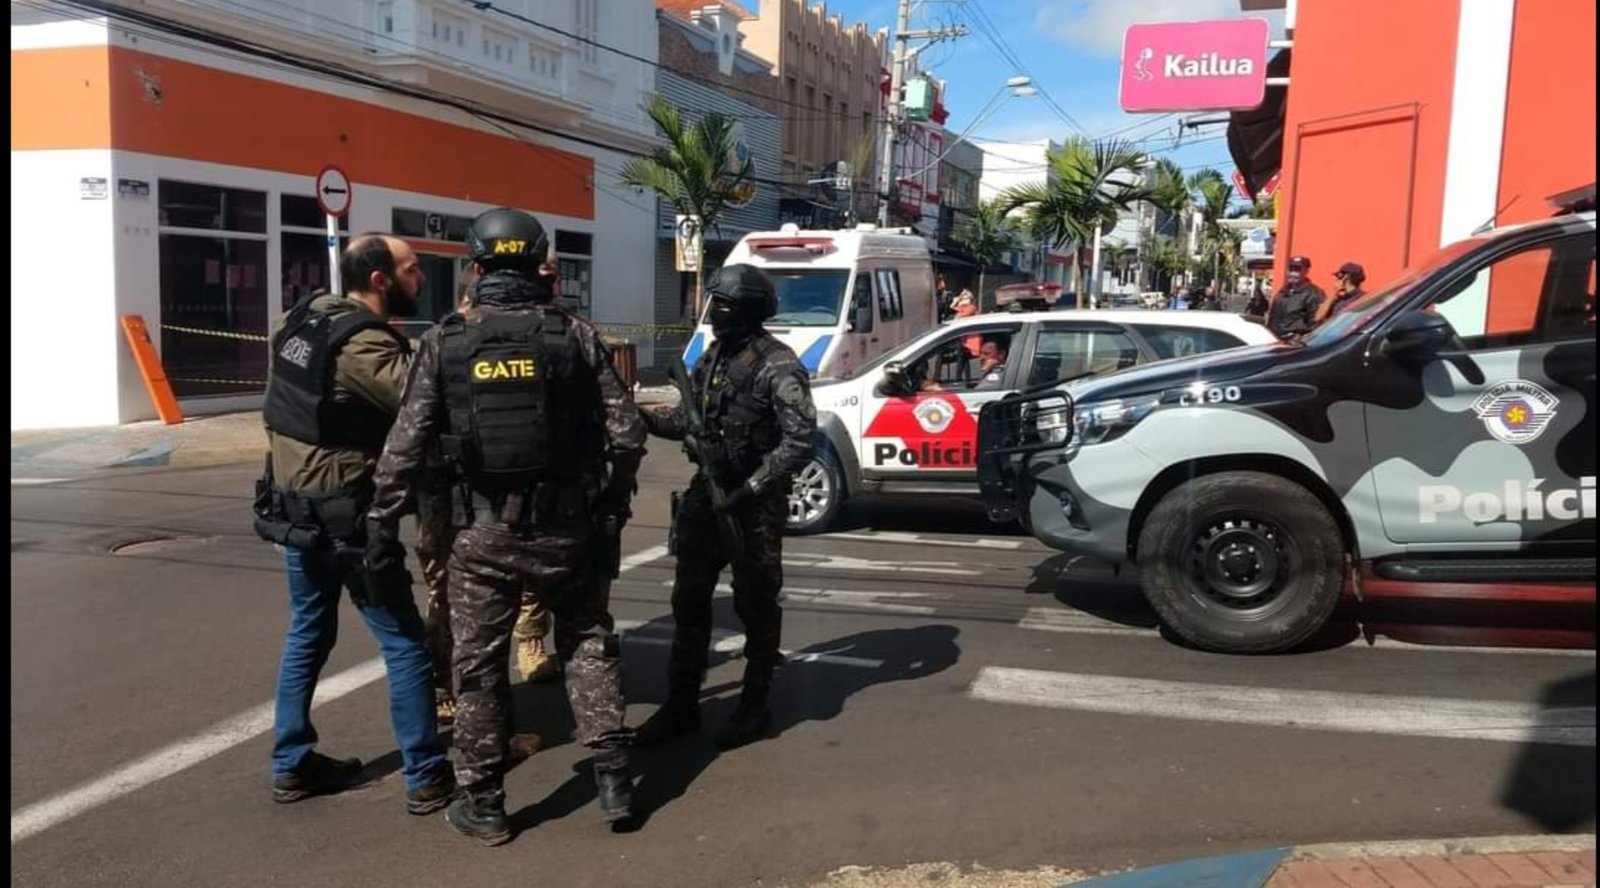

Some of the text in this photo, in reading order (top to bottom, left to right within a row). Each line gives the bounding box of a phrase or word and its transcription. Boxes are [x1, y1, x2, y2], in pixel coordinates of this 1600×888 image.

[1164, 52, 1253, 78] Kailua
[494, 240, 525, 254] A-07
[474, 359, 534, 380] GATE
[874, 441, 979, 466] Políci
